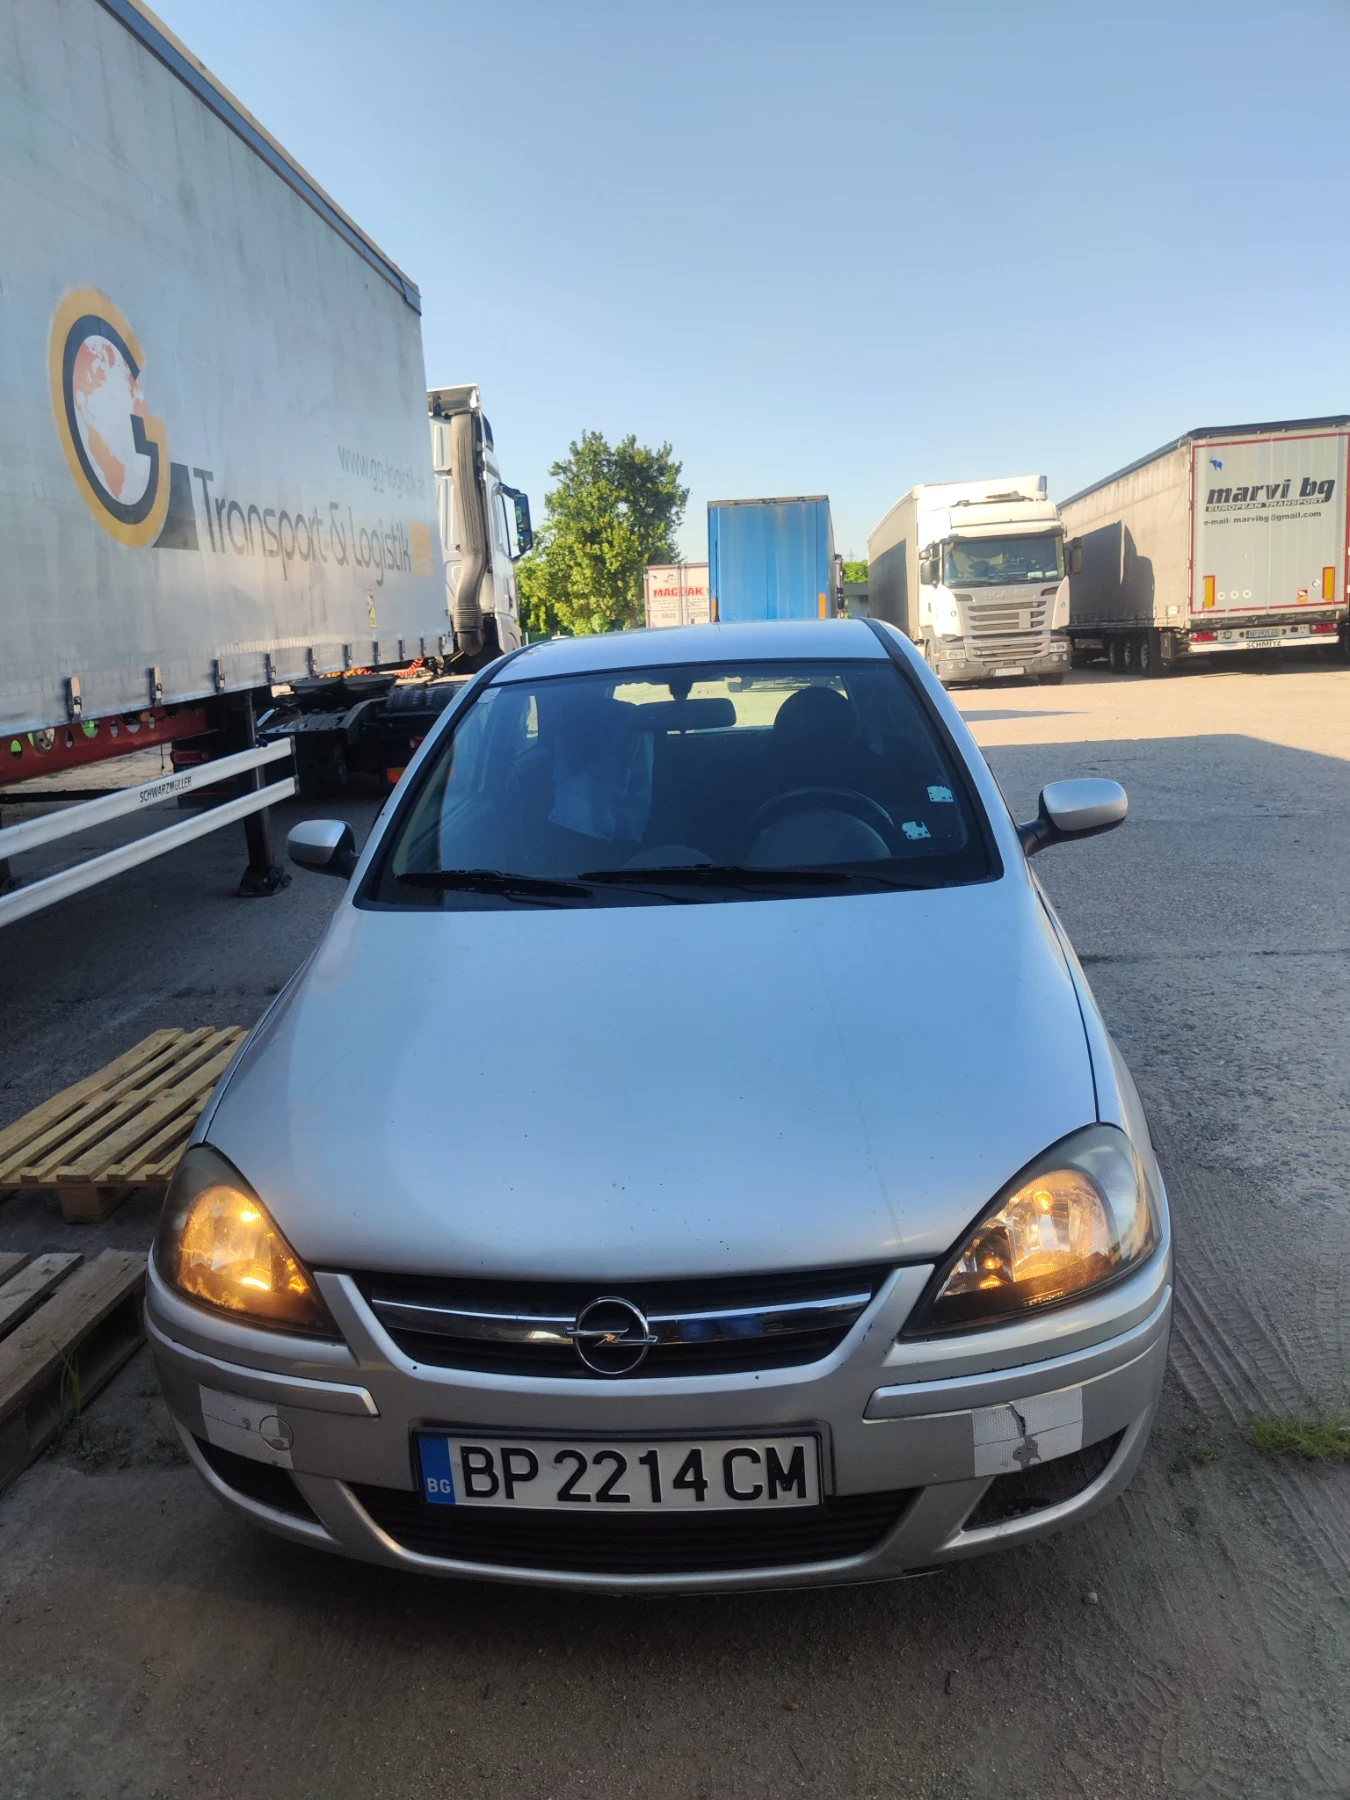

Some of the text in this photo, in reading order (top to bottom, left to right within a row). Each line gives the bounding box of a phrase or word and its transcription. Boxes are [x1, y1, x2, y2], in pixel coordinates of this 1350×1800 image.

[1206, 477, 1336, 504] marvi bg
[1207, 498, 1326, 512] EUROPEAN TRANSPORT
[193, 467, 412, 587] Transport & Logistik
[1203, 517, 1232, 526] e-mail:
[460, 1446, 807, 1503] BP 2214 CM
[427, 1478, 451, 1494] BG
